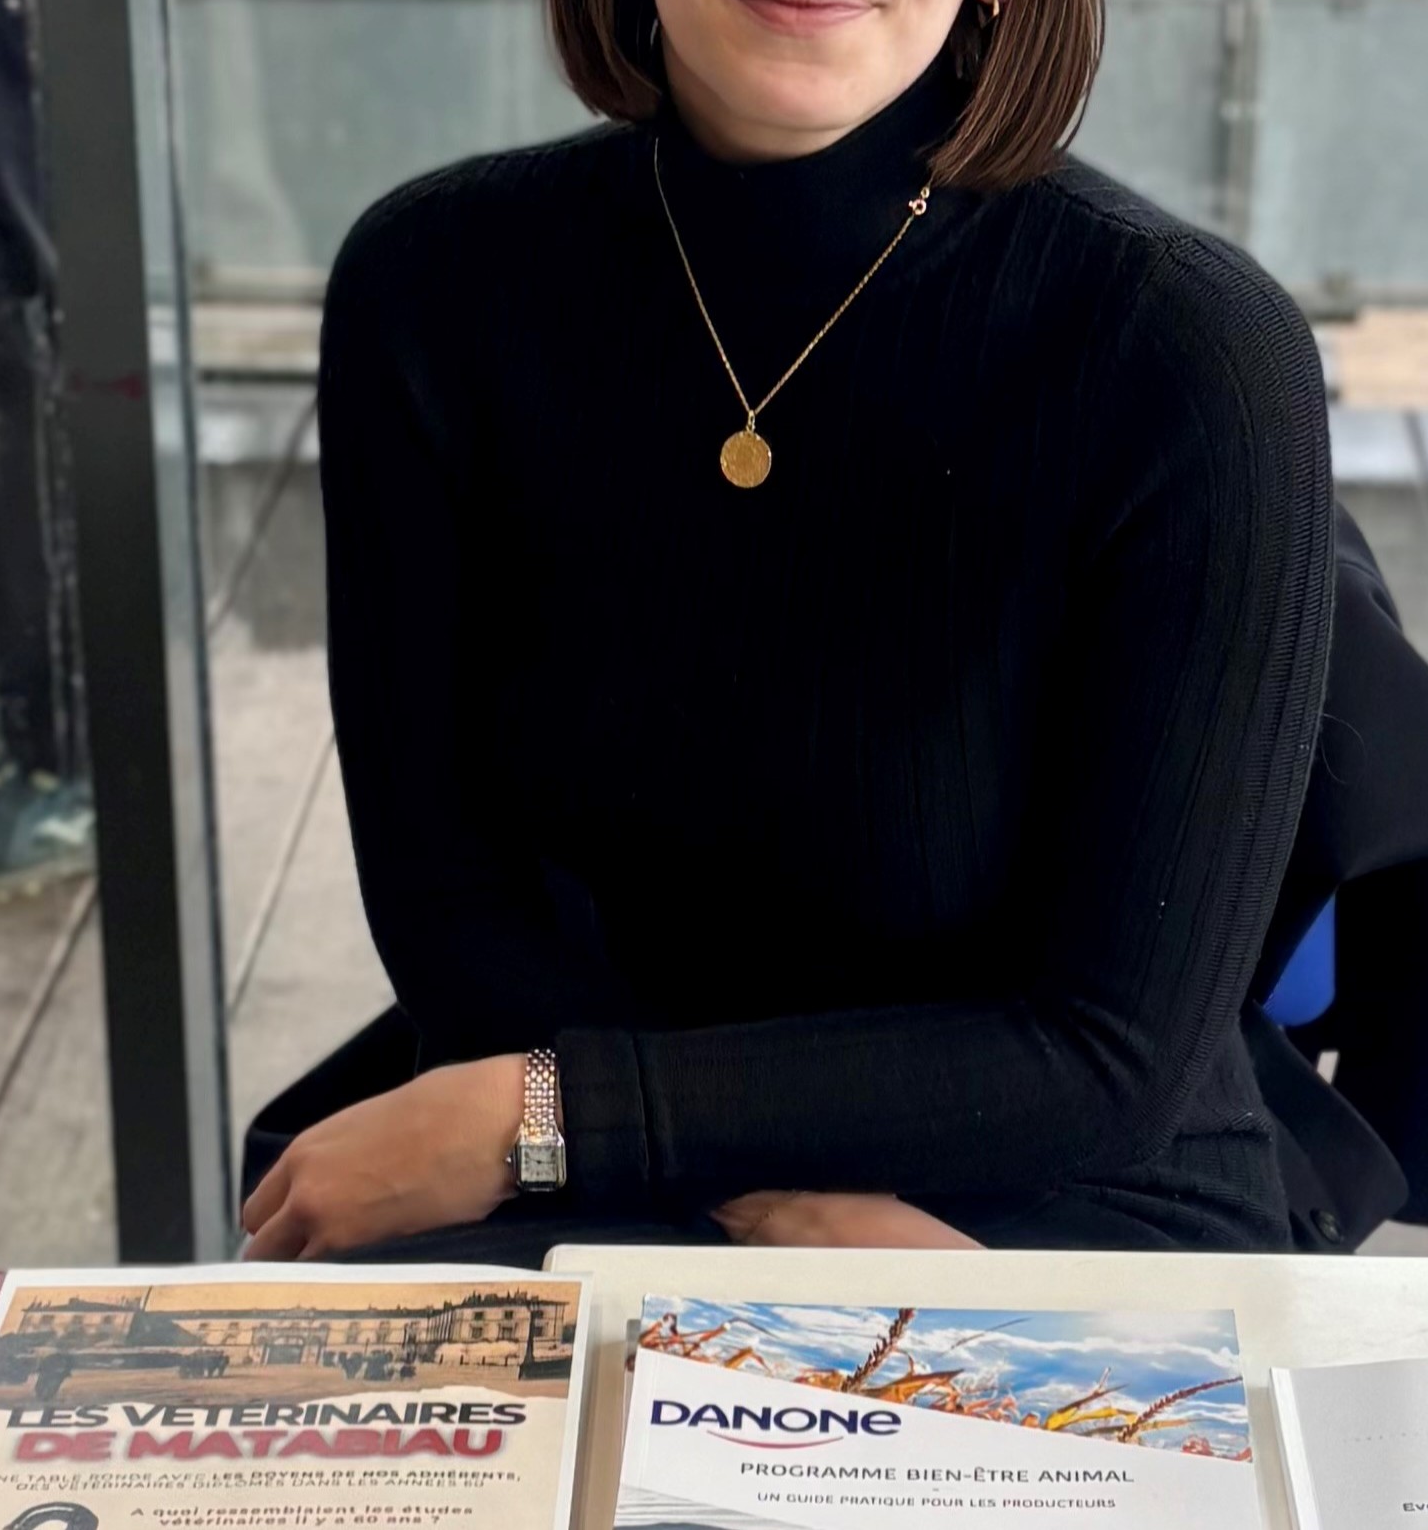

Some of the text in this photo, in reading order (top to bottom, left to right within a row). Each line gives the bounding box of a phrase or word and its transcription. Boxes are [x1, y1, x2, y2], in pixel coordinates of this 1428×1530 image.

[7, 1405, 109, 1428] LES
[15, 1427, 504, 1463] DE MATABIAU
[28, 1473, 81, 1484] TABLE
[89, 1473, 152, 1482] RONDE
[212, 1472, 244, 1481] LES
[251, 1471, 324, 1480] DOYENS
[740, 1462, 1135, 1483] PROGRAMME BIEN-ÊTRE ANIMAL
[16, 1481, 50, 1491] DES
[757, 1492, 1117, 1509] UN GUIDE PRATIQUE POUR LES PRODUCTEURS
[153, 1507, 199, 1518] quoi
[207, 1505, 355, 1517] ressemblaient
[365, 1504, 393, 1515] les
[295, 1514, 307, 1526] il
[315, 1517, 326, 1527] y
[334, 1517, 345, 1525] a
[354, 1515, 379, 1525] 60
[387, 1515, 422, 1525] ans
